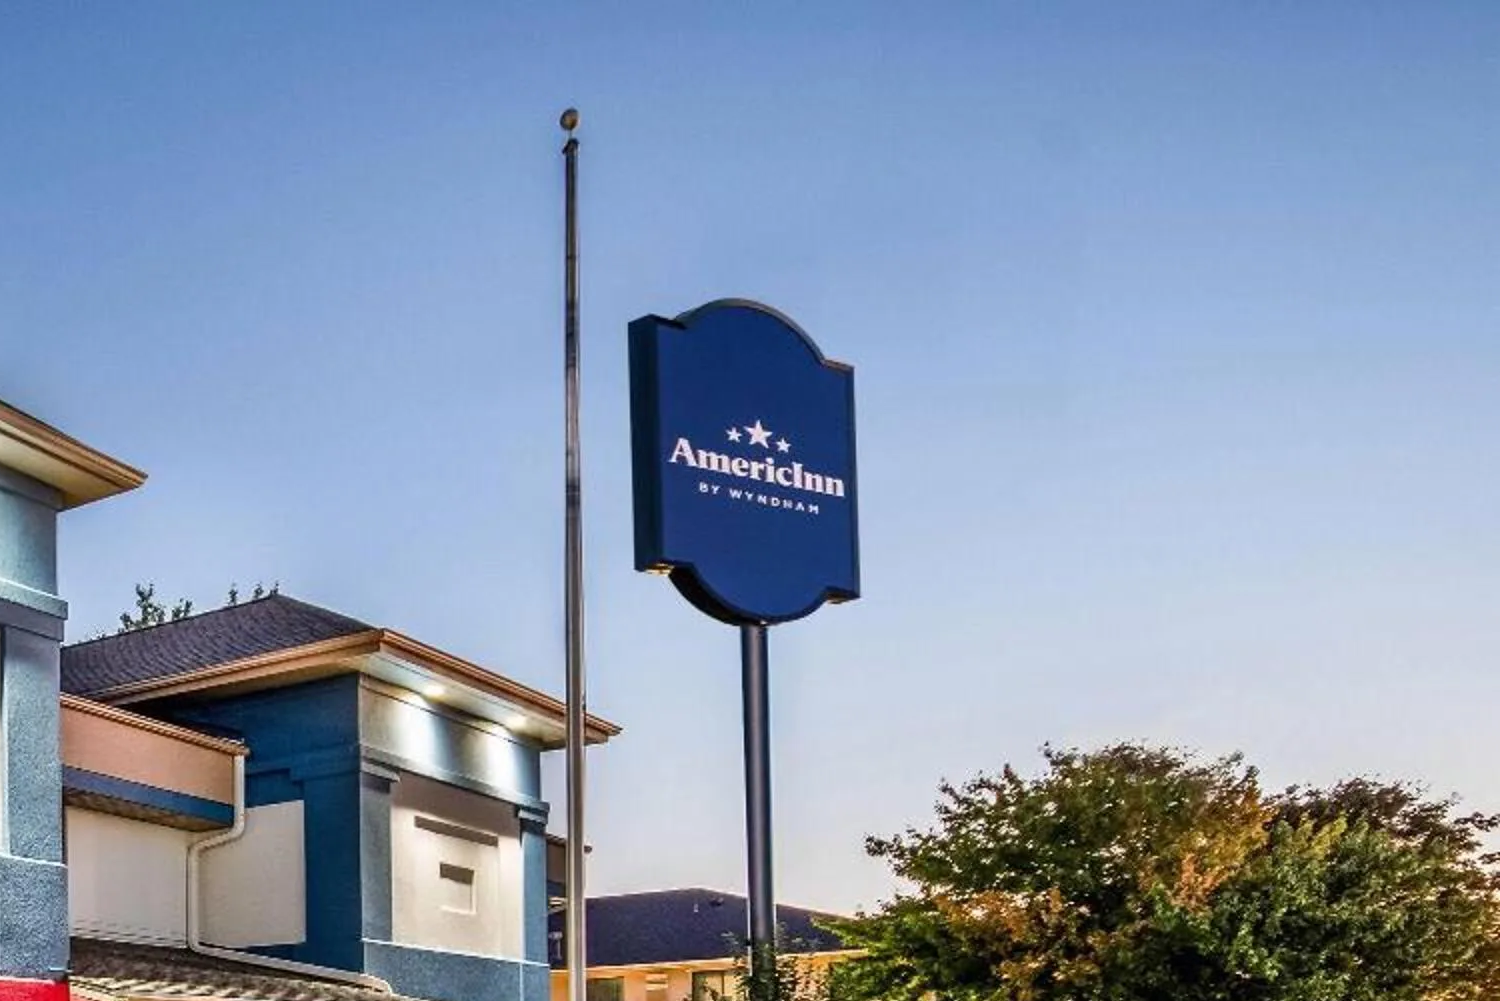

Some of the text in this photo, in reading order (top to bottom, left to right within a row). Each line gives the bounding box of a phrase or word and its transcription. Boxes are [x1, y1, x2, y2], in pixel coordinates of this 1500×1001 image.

[668, 437, 846, 497] AmericInn
[699, 482, 820, 515] BY WYNDHAM
